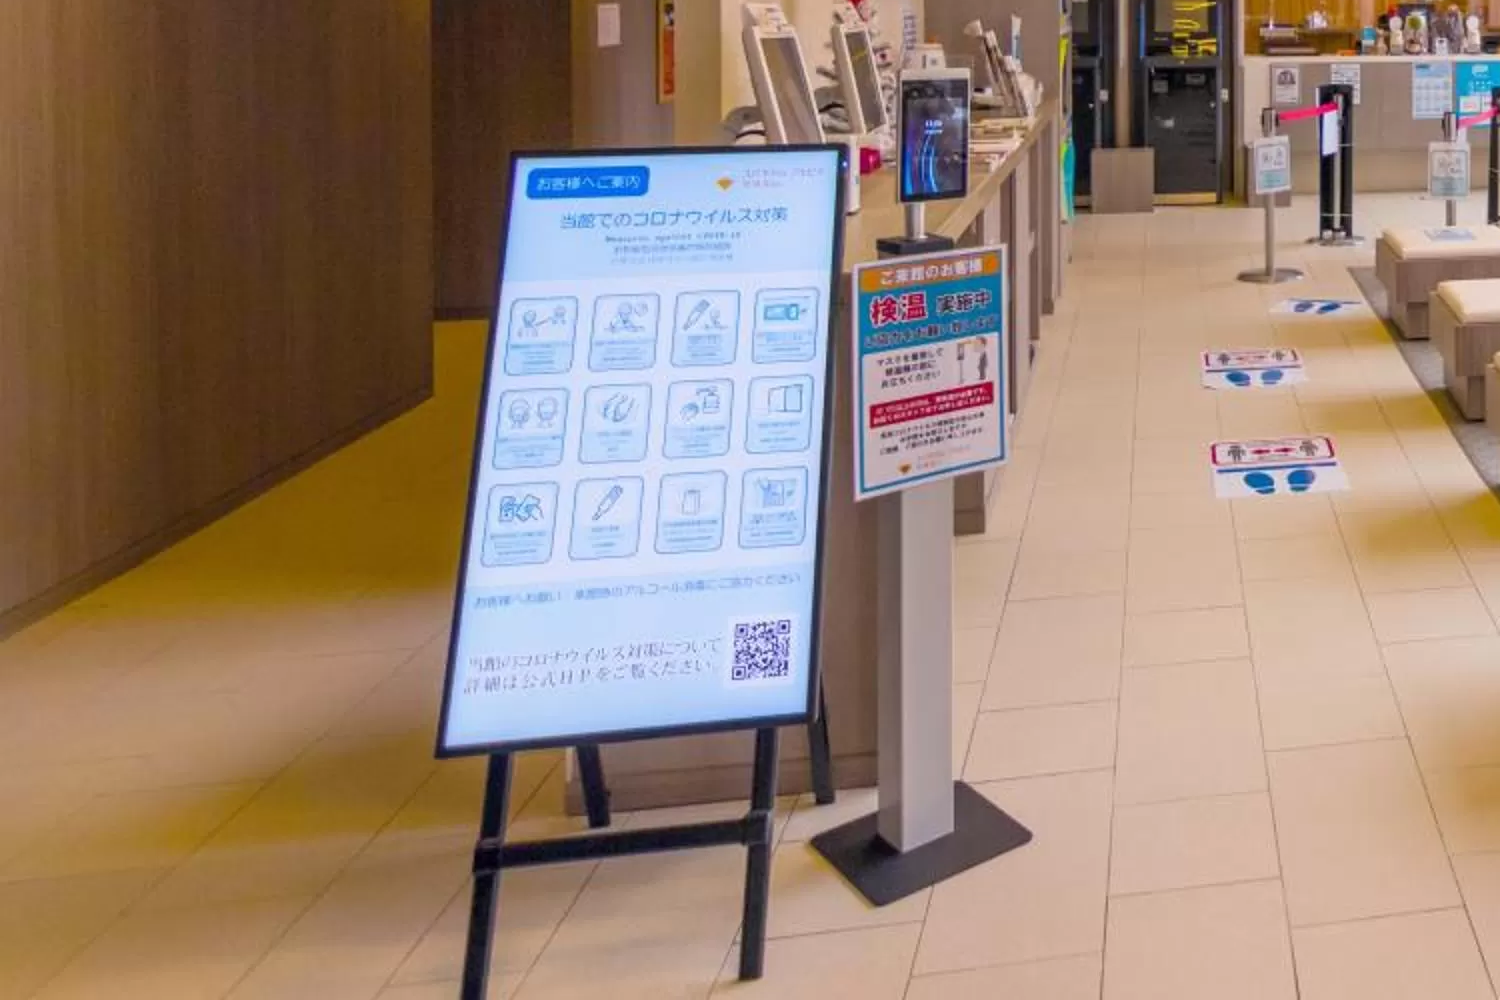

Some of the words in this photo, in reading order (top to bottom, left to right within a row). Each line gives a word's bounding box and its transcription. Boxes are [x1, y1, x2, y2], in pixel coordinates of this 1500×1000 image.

[559, 207, 788, 229] 当館でのコロナウイルス対策
[880, 257, 984, 286] ご来館のお客様
[870, 290, 929, 329] 検温
[936, 288, 993, 316] 実施中
